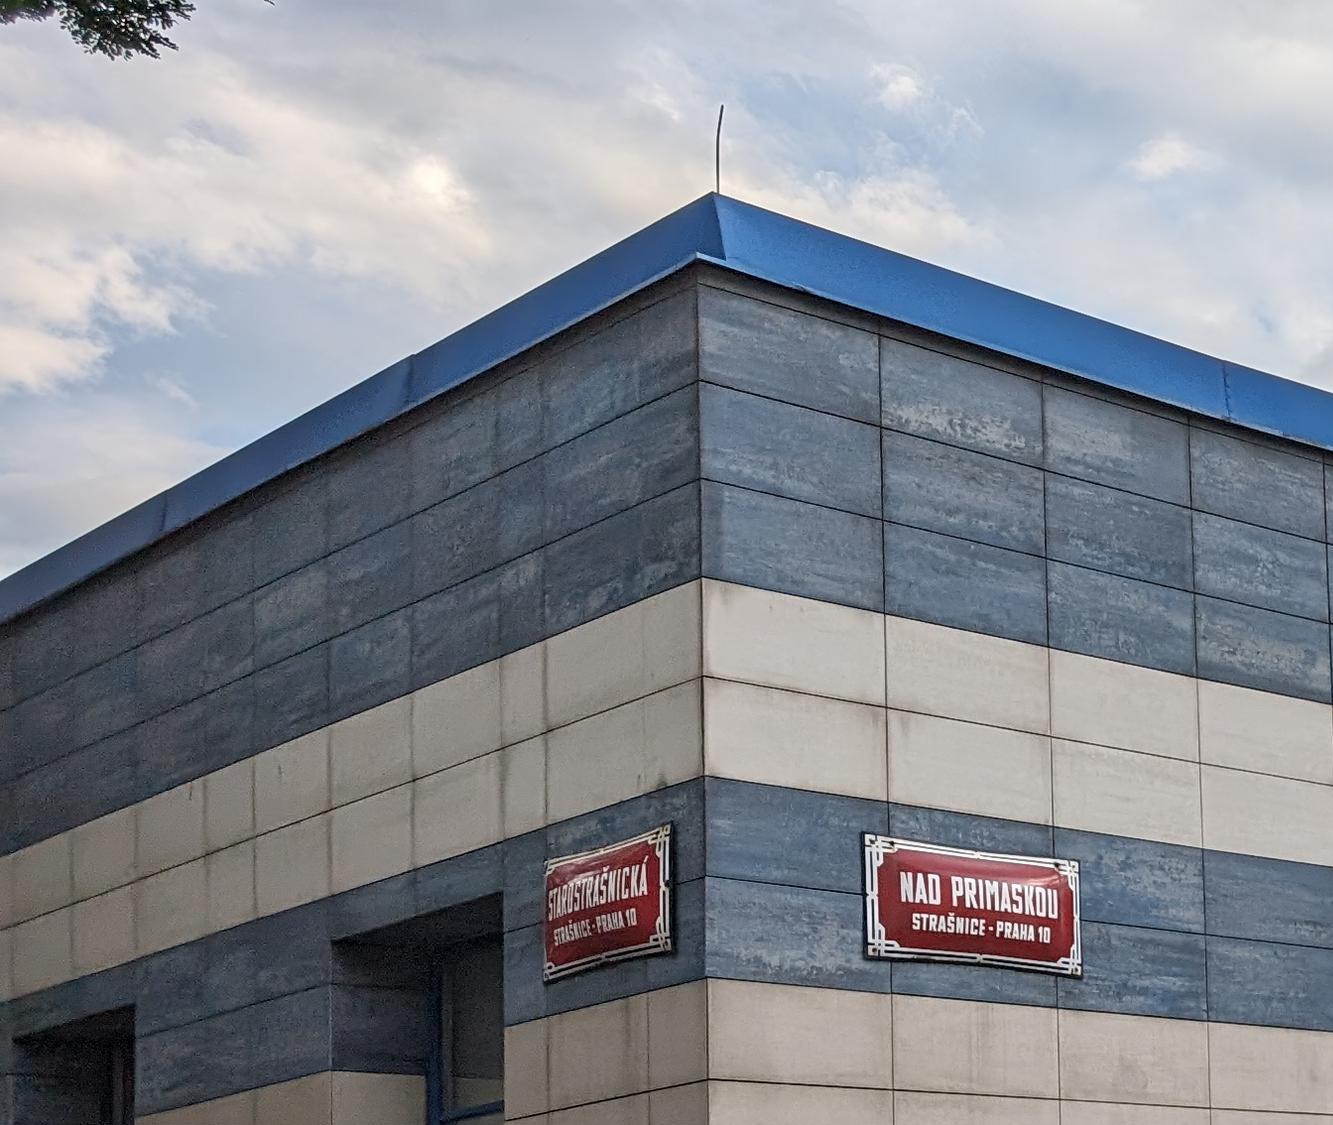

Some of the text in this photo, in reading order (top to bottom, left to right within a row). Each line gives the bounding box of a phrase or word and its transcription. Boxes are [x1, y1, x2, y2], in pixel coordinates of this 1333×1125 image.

[548, 855, 649, 921] STAROSTRAŠNICKÁ
[900, 871, 1059, 920] NAD PRIMASKOU
[554, 919, 592, 946] STRAŠNICE
[596, 911, 625, 934] PRAHA
[625, 907, 637, 926] 10
[912, 912, 986, 936] STRAŠNICE
[996, 920, 1035, 942] PRAHA
[1037, 926, 1051, 943] 10
